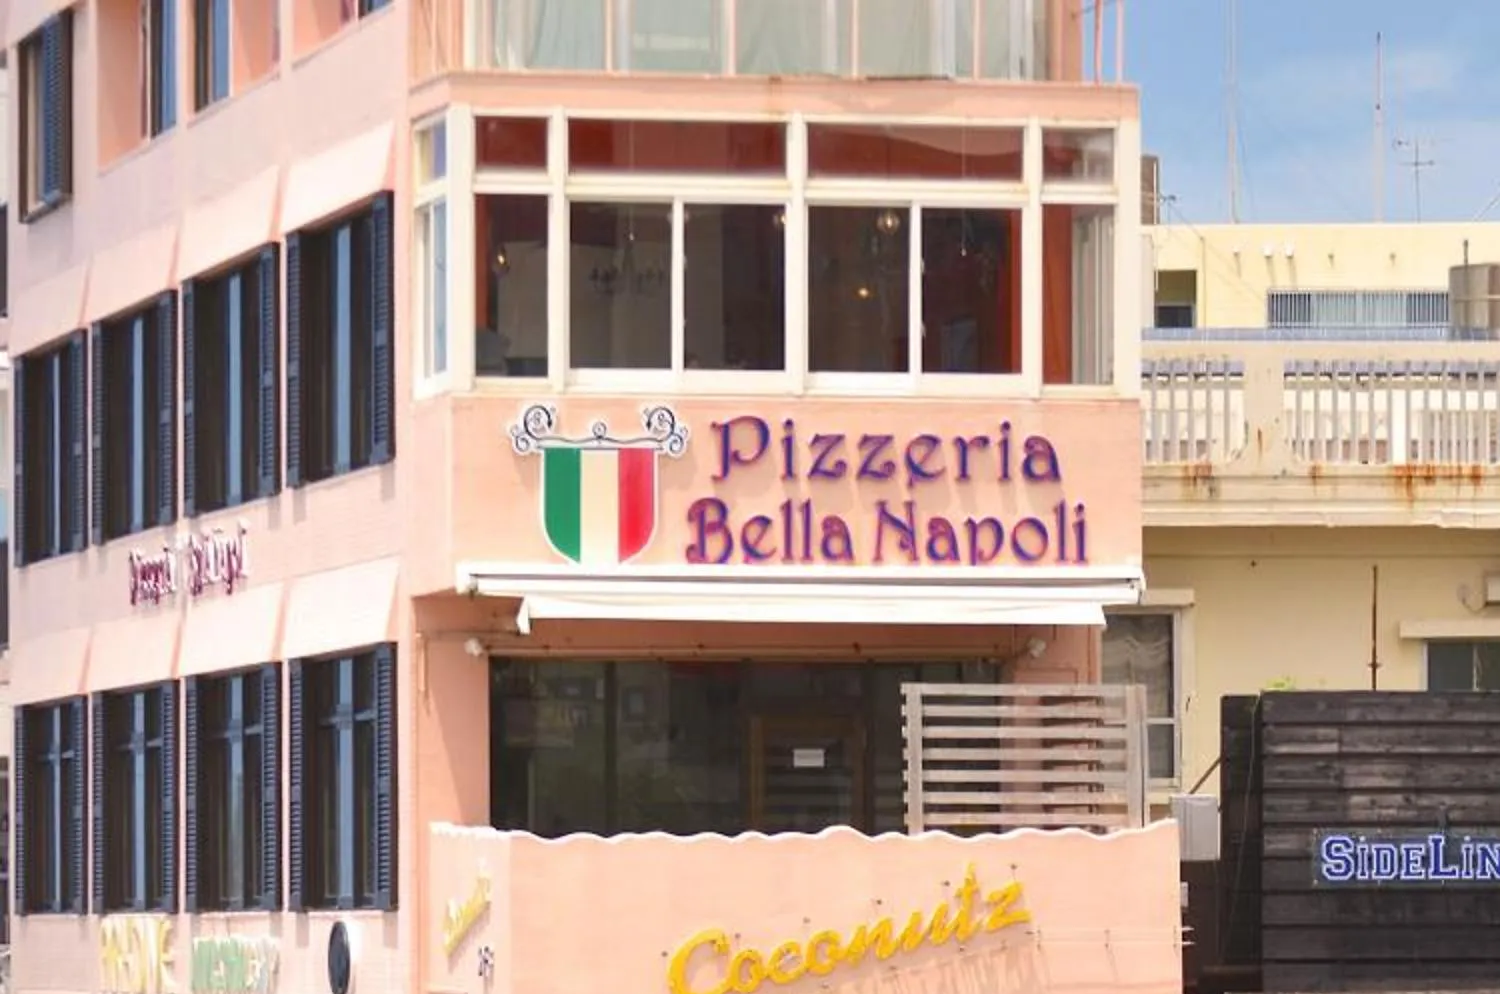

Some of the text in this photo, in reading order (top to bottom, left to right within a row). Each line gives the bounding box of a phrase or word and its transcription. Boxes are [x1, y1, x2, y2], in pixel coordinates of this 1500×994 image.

[711, 415, 1061, 486] Pizzeria
[686, 497, 1089, 565] Bella Napoli
